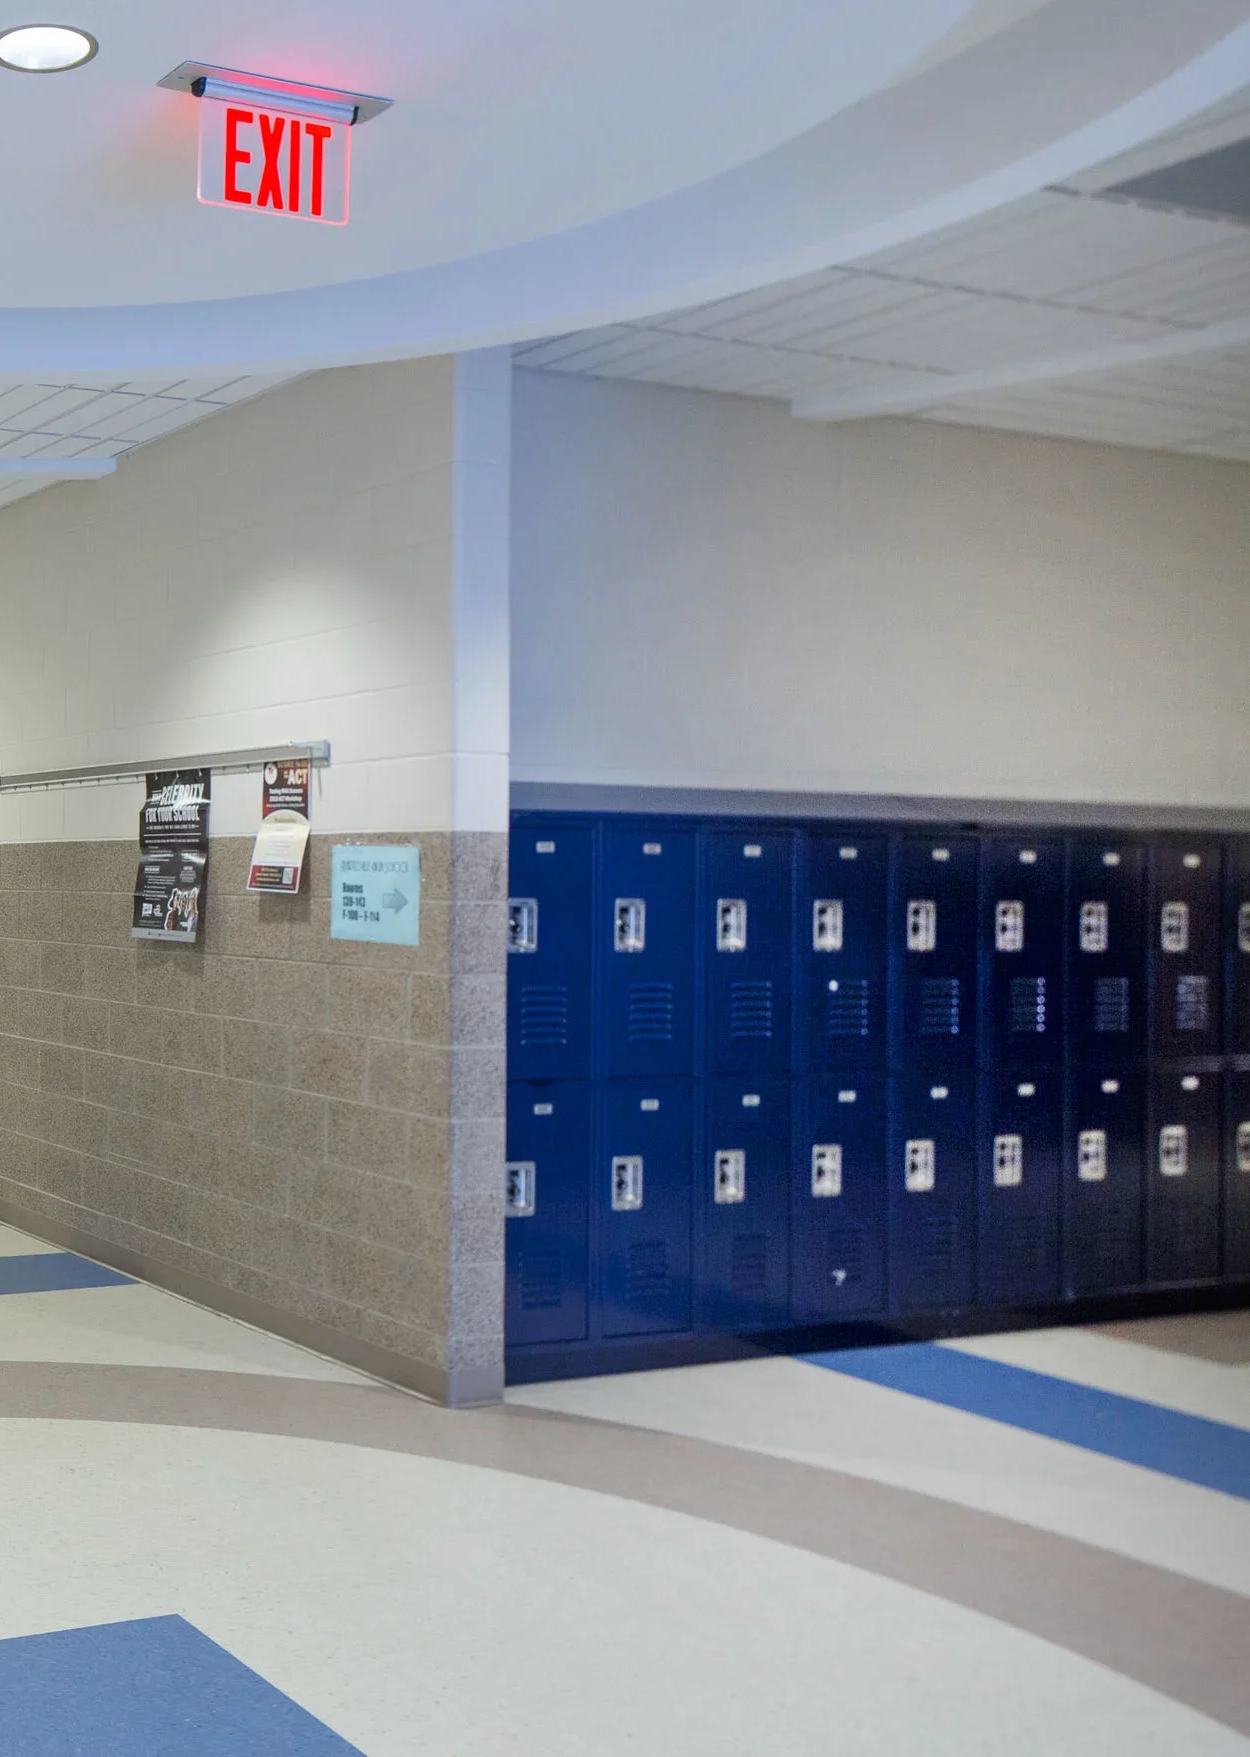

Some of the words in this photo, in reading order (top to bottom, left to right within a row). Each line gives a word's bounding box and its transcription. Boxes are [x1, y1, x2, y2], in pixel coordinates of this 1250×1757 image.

[224, 108, 332, 217] EXIT
[287, 769, 308, 785] ACT
[159, 783, 205, 806] CELEBRITY
[145, 807, 157, 823] FOR
[173, 804, 200, 821] SCHOOL
